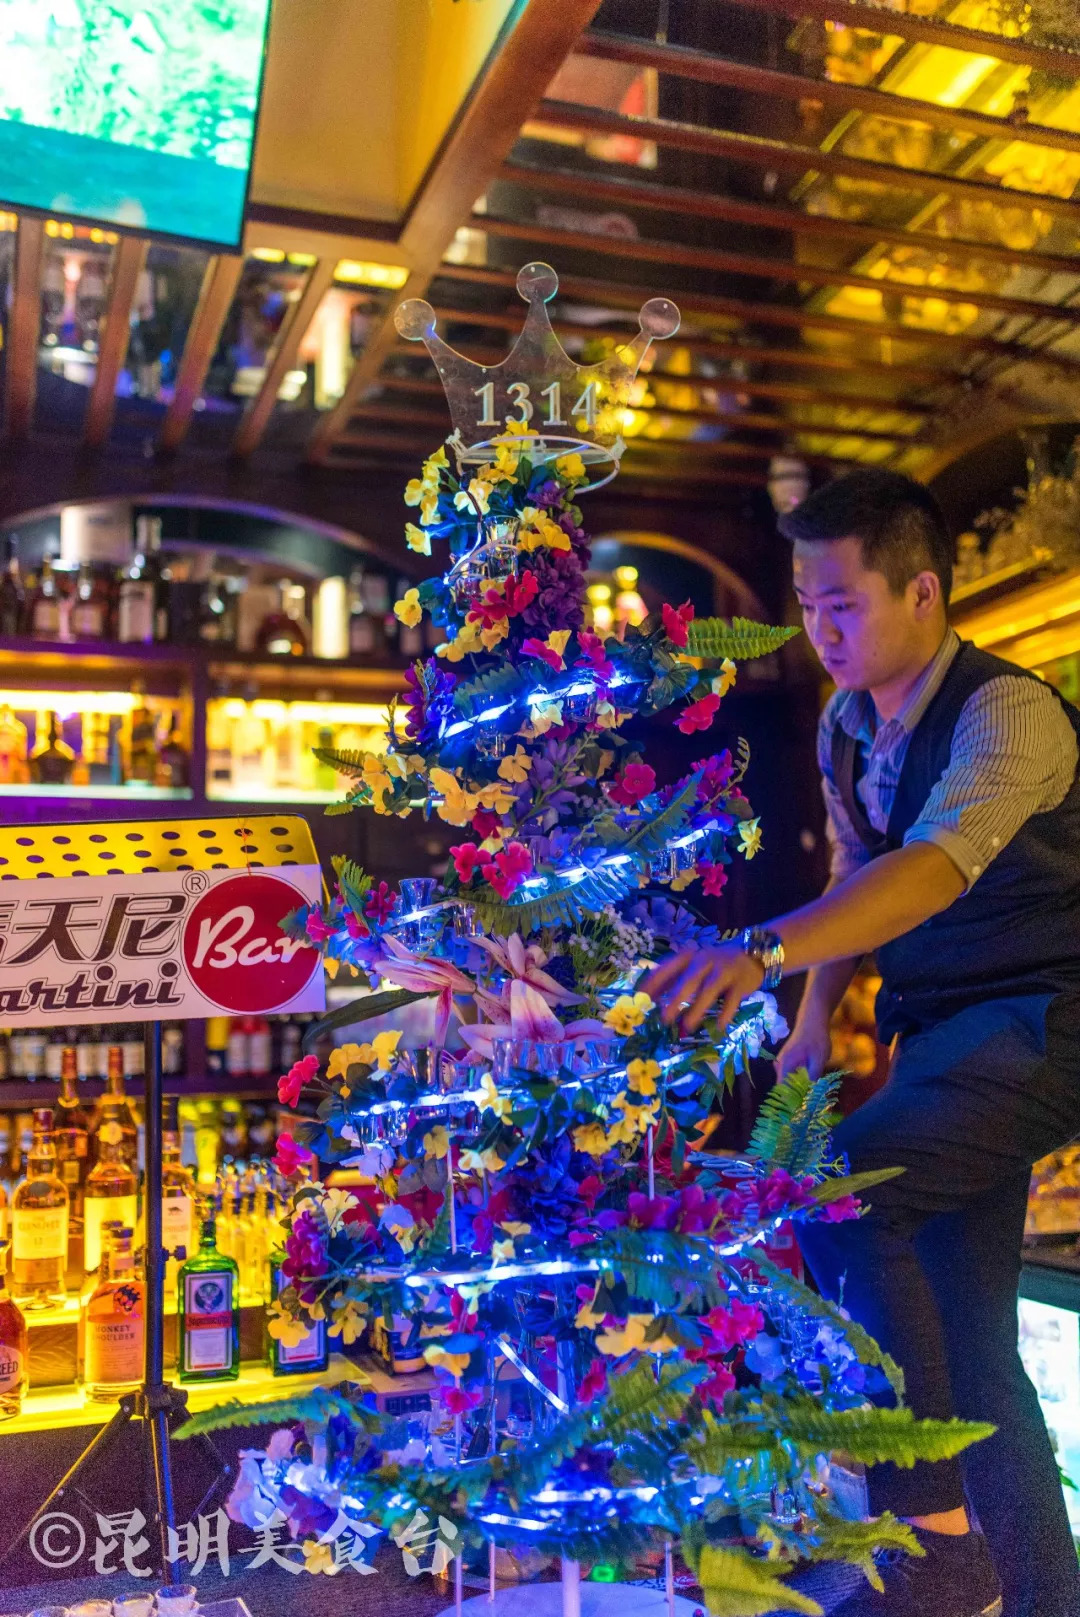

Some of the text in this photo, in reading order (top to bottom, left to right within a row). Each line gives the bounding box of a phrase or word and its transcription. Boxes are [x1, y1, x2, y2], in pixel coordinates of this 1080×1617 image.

[474, 381, 600, 427] 1314
[192, 905, 312, 969] Bar
[0, 1360, 18, 1376] EED
